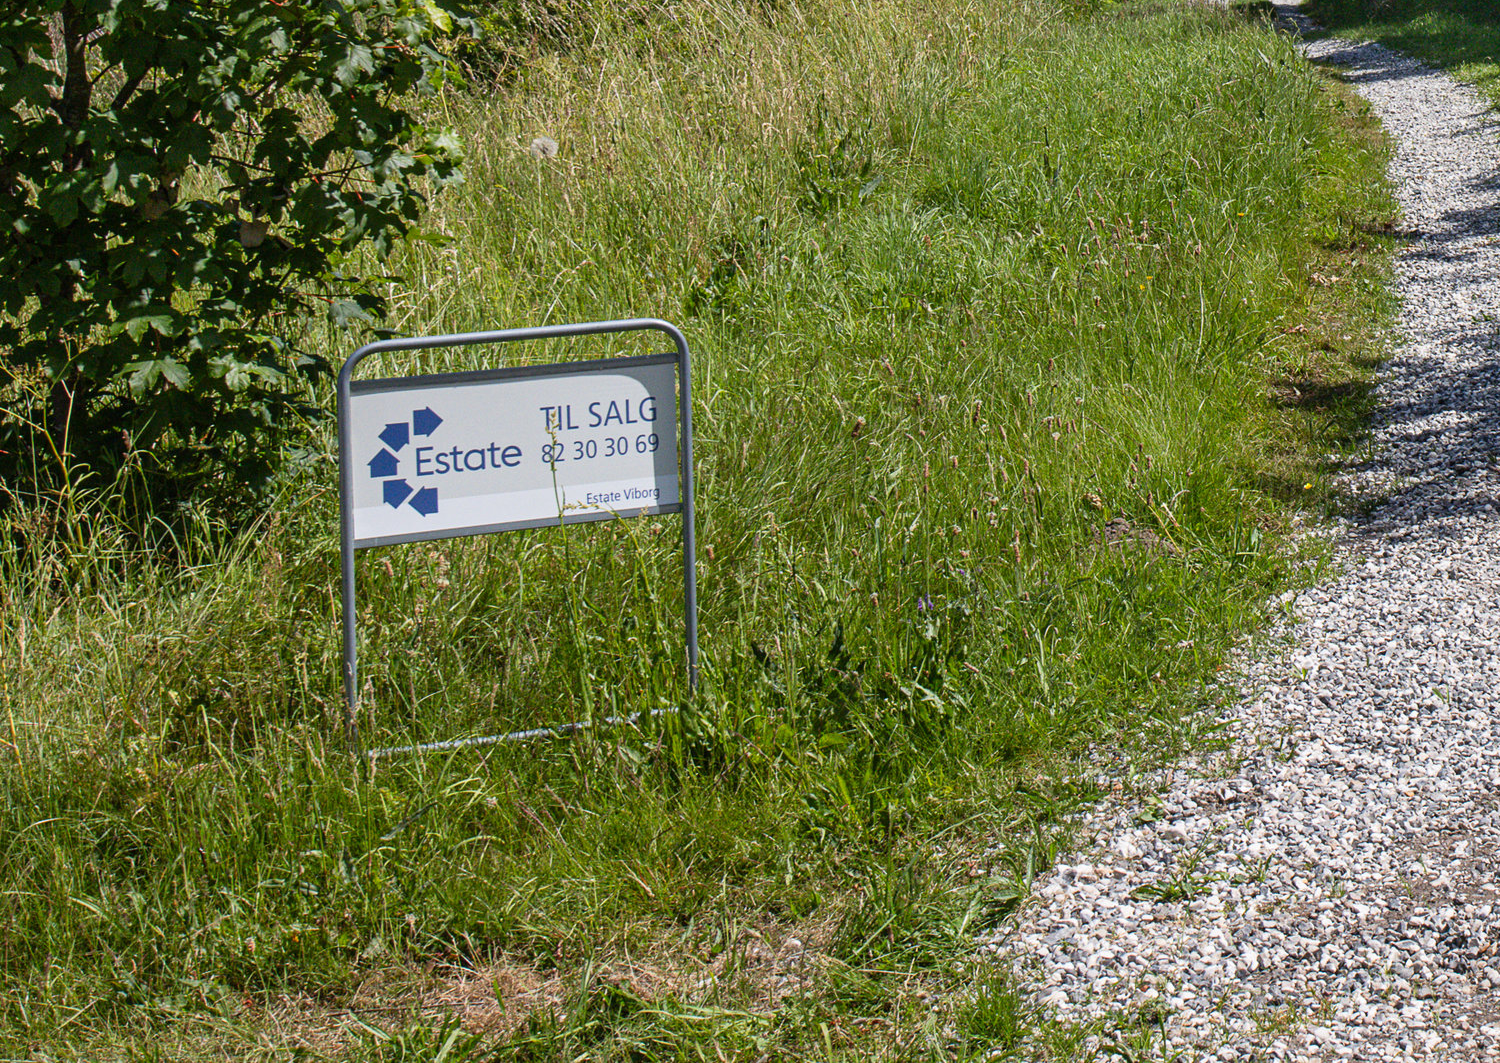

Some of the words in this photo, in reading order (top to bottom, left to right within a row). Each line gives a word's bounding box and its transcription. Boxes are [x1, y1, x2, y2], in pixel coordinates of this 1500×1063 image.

[540, 404, 579, 431] TIL
[588, 396, 658, 428] SALG
[415, 441, 523, 476] Estate
[541, 442, 565, 463] 82
[573, 439, 597, 461] 30
[604, 436, 628, 457] 30
[635, 433, 659, 454] 69
[586, 490, 621, 505] Estate
[623, 486, 660, 502] Viborg
